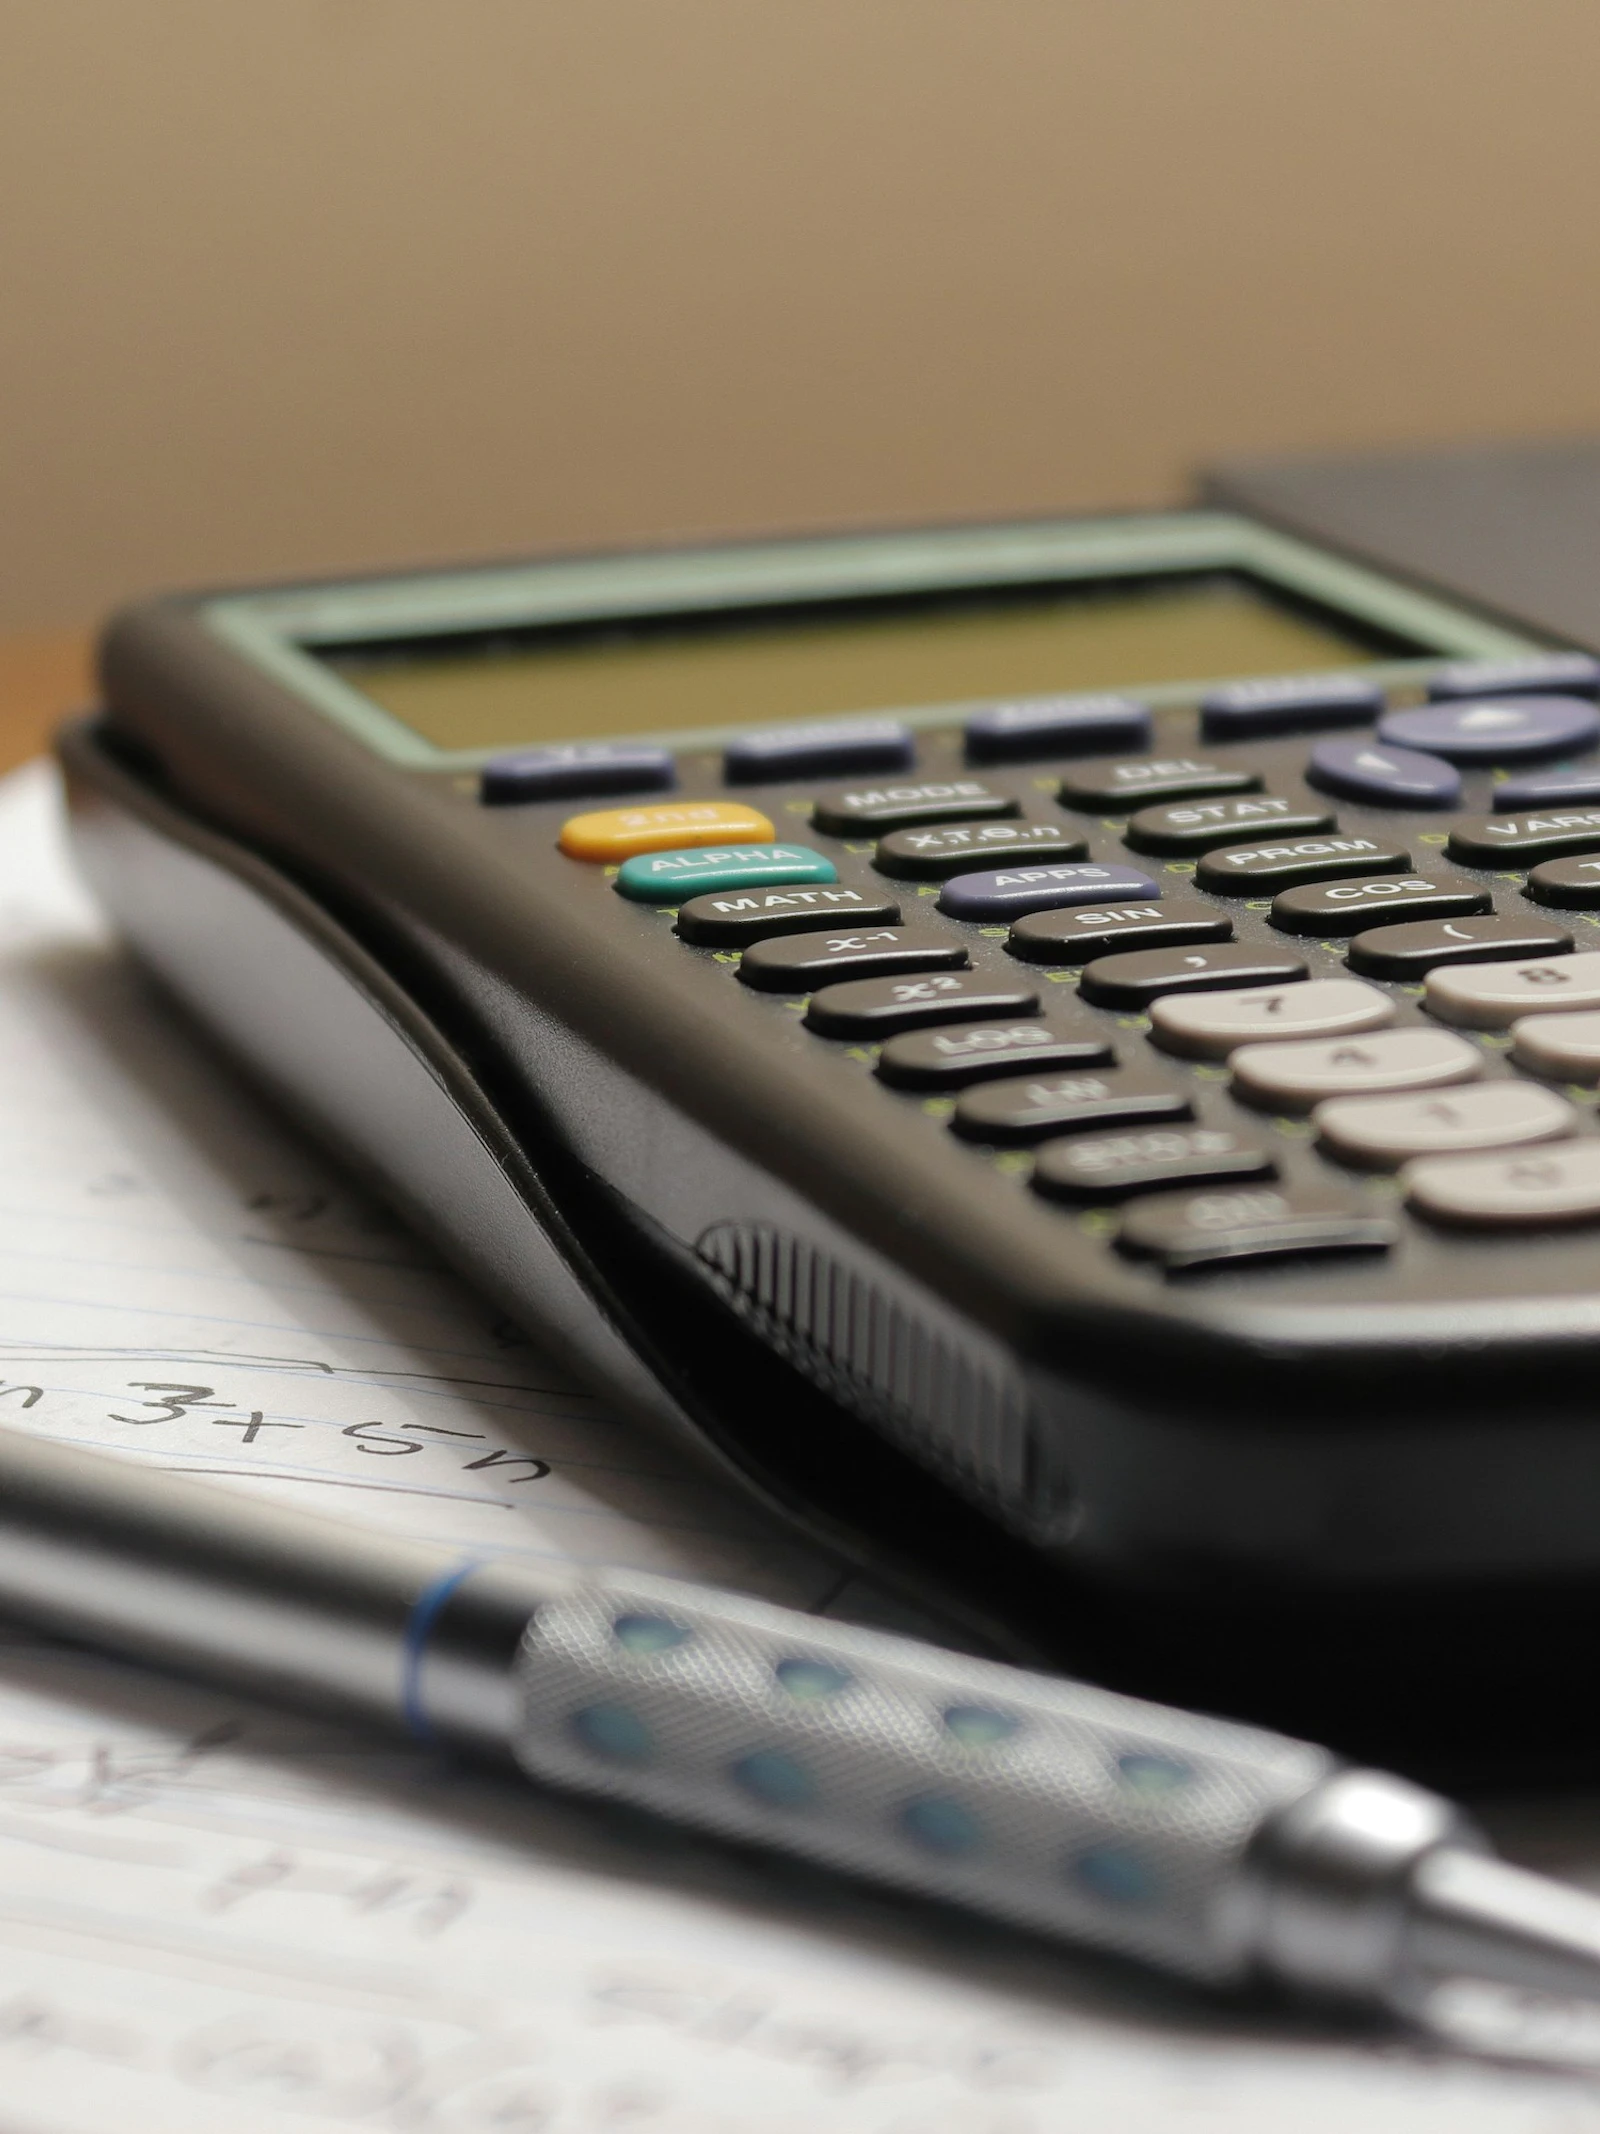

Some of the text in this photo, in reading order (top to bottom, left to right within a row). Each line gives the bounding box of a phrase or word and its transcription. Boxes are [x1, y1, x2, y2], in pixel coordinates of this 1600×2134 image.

[1114, 760, 1214, 780] DEL
[845, 782, 989, 808] MODE
[620, 807, 719, 827] 2nd
[1167, 800, 1289, 824] STAT
[651, 848, 803, 873] ALPHA
[1225, 840, 1378, 866] PRGM
[995, 867, 1112, 887] APPS
[1325, 879, 1437, 901] COS
[712, 890, 863, 913] MATH
[1074, 907, 1164, 925] SIN
[1517, 966, 1572, 986] 8
[932, 1026, 1055, 1055] LOG
